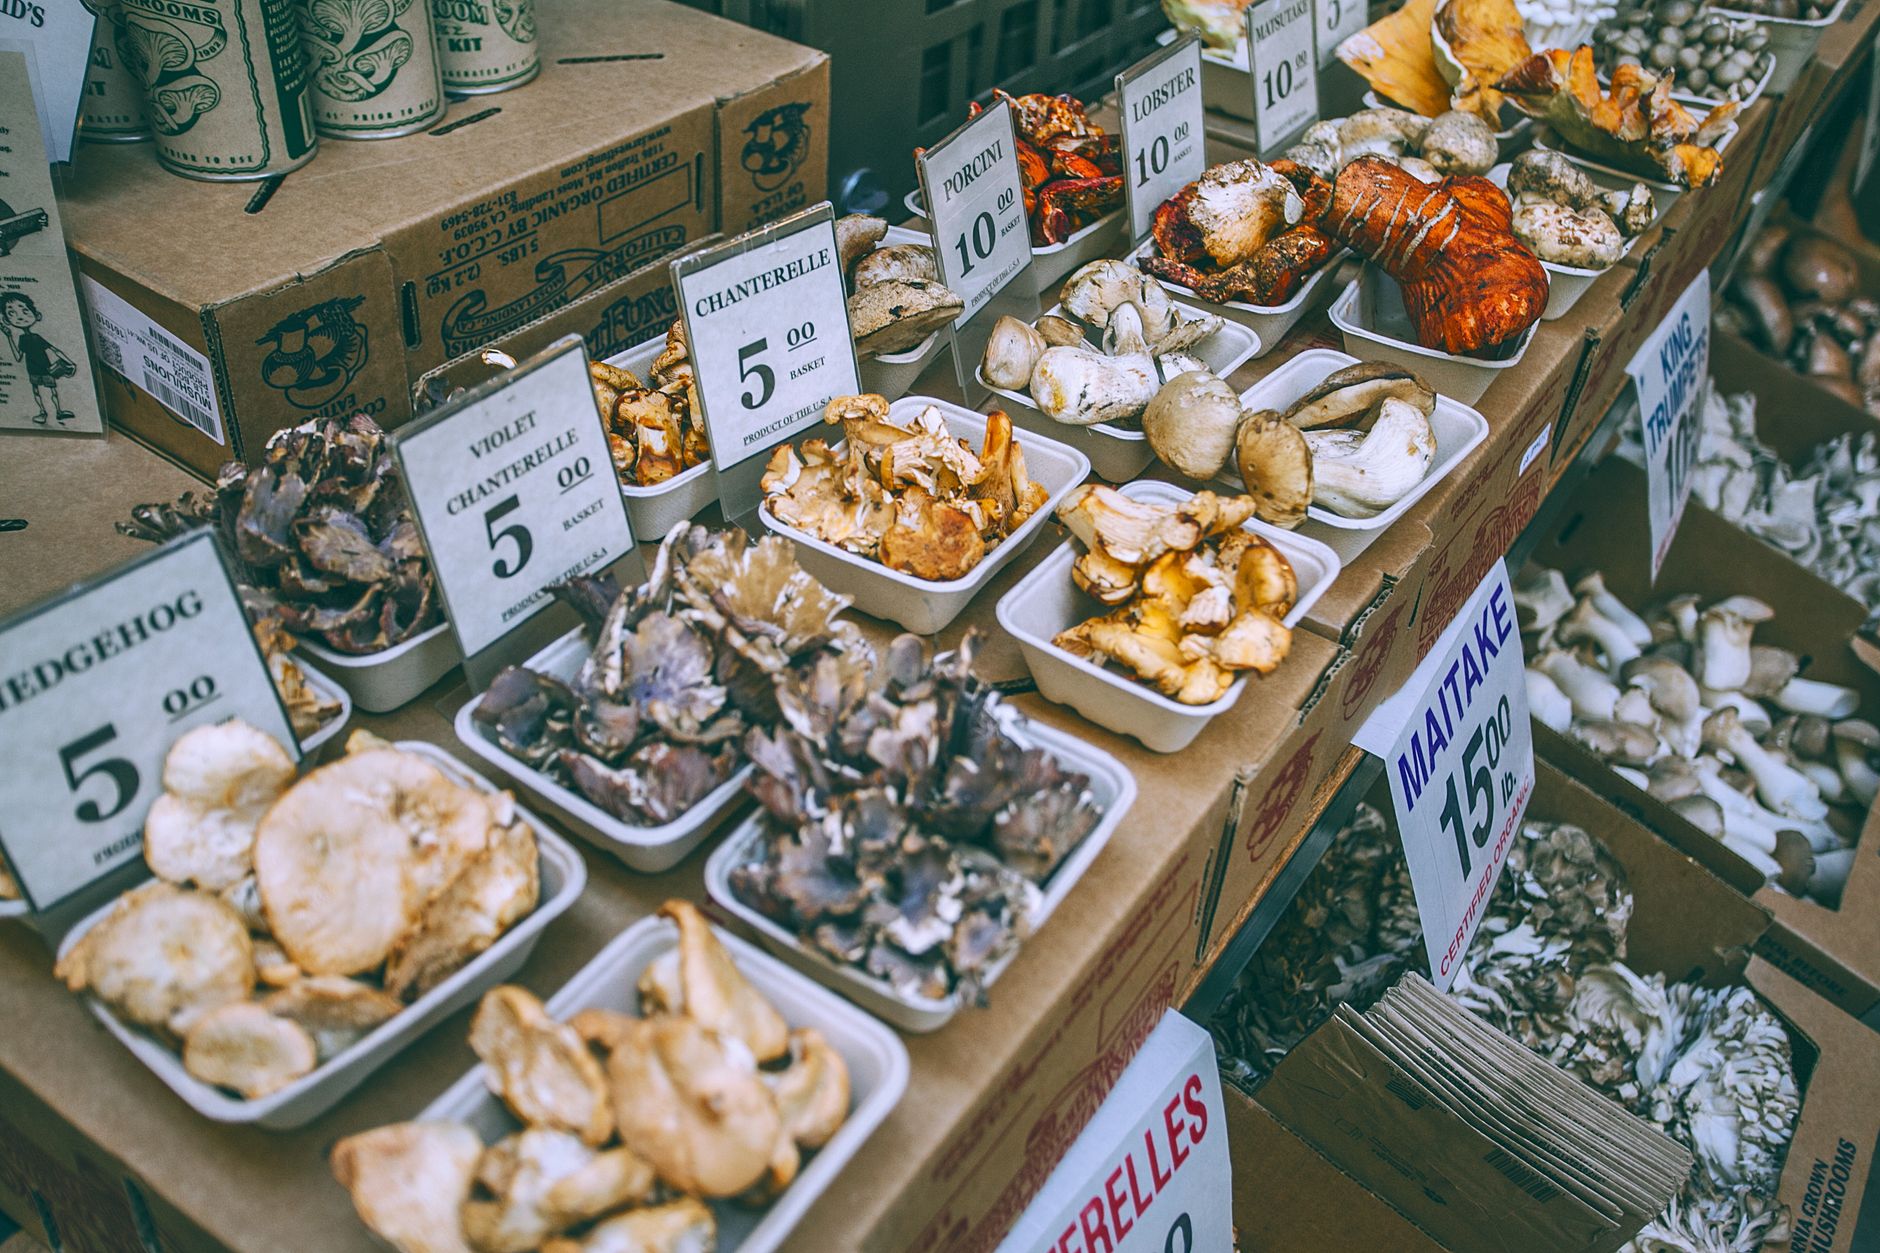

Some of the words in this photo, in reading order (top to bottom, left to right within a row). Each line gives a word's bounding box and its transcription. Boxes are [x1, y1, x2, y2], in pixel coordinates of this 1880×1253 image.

[447, 37, 482, 52] KIT
[1132, 67, 1197, 125] LOBSTER
[1263, 60, 1293, 111] 10
[605, 151, 679, 194] CERTIFIED
[942, 138, 1004, 204] PORCINI
[1135, 135, 1170, 189] 10
[509, 189, 555, 214] Landing,
[530, 184, 604, 229] ORGANIC
[556, 177, 584, 194] Moss
[440, 190, 518, 232] 831-728-5469
[453, 217, 489, 242] 95039
[490, 209, 507, 226] CA
[506, 217, 529, 240] BY
[1001, 215, 1022, 239] BASKET
[438, 228, 503, 267] C.C.O.F.
[496, 242, 528, 267] LBS.
[529, 237, 540, 254] 5
[955, 210, 997, 280] 10
[695, 248, 832, 318] CHANTERELLE
[789, 356, 826, 380] BASKET
[1660, 311, 1693, 384] KING
[737, 336, 776, 411] 5
[468, 410, 539, 460] VIOLET
[743, 418, 782, 447] PRODUCT
[783, 411, 794, 427] OF
[795, 403, 814, 422] THE
[446, 427, 581, 517] CHANTERELLE
[483, 493, 534, 581] 5
[562, 497, 606, 533] BASKET
[1397, 581, 1513, 815] MAITAKE
[57, 721, 140, 824] 5
[1501, 767, 1518, 810] lb.
[1439, 862, 1494, 978] CERTIFIED
[1493, 774, 1531, 856] ORGANIC
[1801, 1157, 1829, 1218] GROWN
